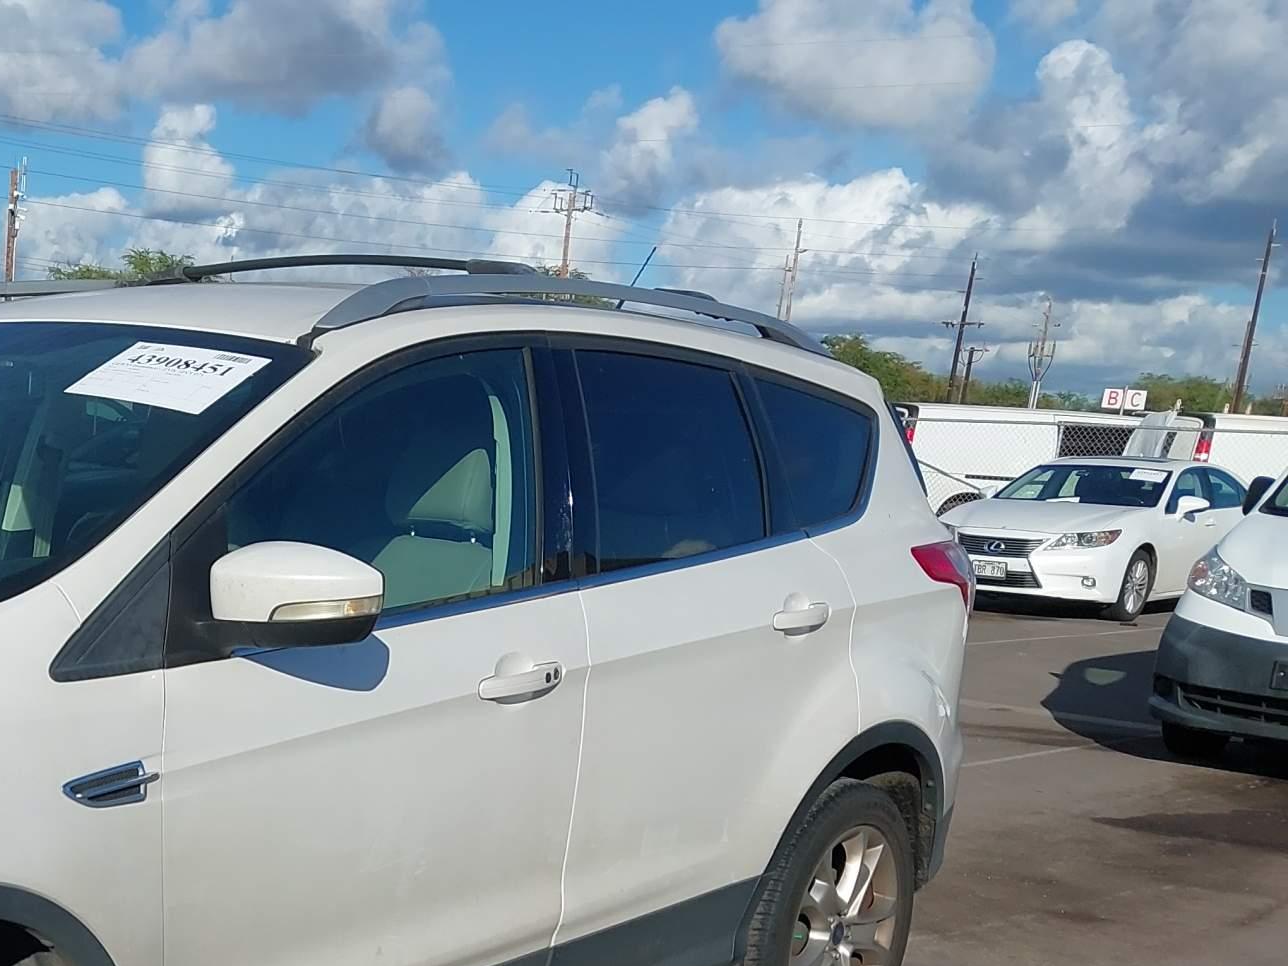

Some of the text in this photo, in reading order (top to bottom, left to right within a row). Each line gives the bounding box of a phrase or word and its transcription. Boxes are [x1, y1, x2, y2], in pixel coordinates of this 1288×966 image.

[128, 353, 235, 376] 43908451
[1107, 390, 1119, 406] B
[1130, 392, 1142, 407] C
